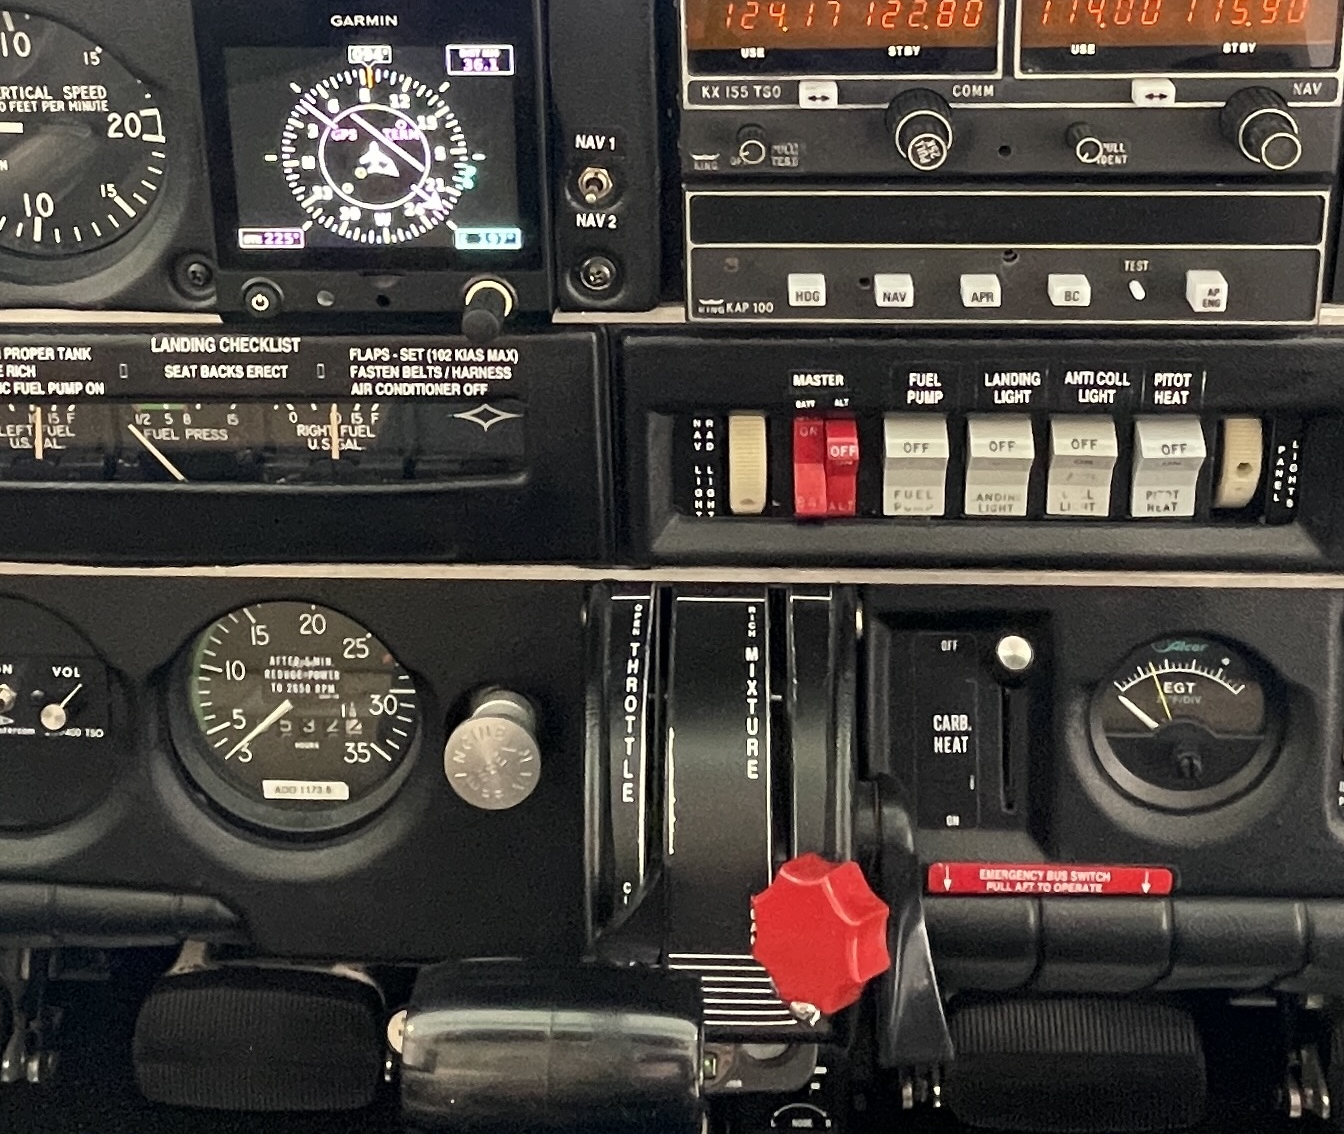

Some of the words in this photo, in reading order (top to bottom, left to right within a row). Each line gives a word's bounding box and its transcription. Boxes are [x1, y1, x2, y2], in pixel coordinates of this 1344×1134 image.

[330, 15, 399, 27] GARMIN
[725, 0, 842, 33] 124.17
[0, 31, 32, 58] 10
[63, 85, 107, 100] SPEED
[952, 85, 995, 98] COMM
[1292, 82, 1323, 96] NAV
[107, 112, 142, 138] 20
[575, 134, 604, 149] NAV
[609, 135, 616, 150] 1
[575, 214, 605, 228] NAV
[608, 214, 617, 228] 2
[1124, 260, 1150, 272] TEST
[795, 289, 820, 303] HDG
[882, 289, 908, 304] NAV
[970, 289, 995, 303] APR
[1063, 289, 1081, 303] BC
[725, 300, 753, 315] KAP
[754, 300, 774, 314] 100
[151, 337, 216, 353] LANDING
[219, 337, 301, 353] CHECKLIST
[4, 346, 55, 361] PROPER
[57, 346, 92, 361] TANK
[6, 364, 37, 378] RICH
[164, 364, 198, 379] SEAT
[200, 364, 244, 379] BACKS
[246, 364, 289, 379] ERECT
[1064, 371, 1094, 386] ANTI
[1096, 371, 1131, 386] COLL
[793, 374, 845, 387] MASTER
[909, 373, 942, 387] FUEL
[984, 372, 1041, 387] LANDING
[1154, 372, 1192, 387] PITOT
[351, 382, 372, 396] AIR
[375, 382, 461, 396] CONDITIONER
[463, 382, 488, 396] OFF
[993, 389, 1032, 404] LIGHT
[1078, 389, 1116, 404] LIGHT
[907, 390, 944, 405] PUMP
[1154, 391, 1190, 405] HEAT
[903, 442, 930, 454] OFF
[1071, 439, 1099, 450] OFF
[299, 613, 327, 635] 20
[343, 637, 369, 659] 25
[52, 666, 81, 678] VOL
[226, 660, 246, 681] 10
[1163, 682, 1195, 694] EGT
[745, 646, 759, 780] MIXTURE
[622, 642, 641, 803] THROTTLE
[932, 714, 972, 732] CARB.
[933, 735, 969, 753] HEAT
[979, 869, 1044, 882] EMERGENCY
[1046, 870, 1068, 882] BUS
[1070, 870, 1111, 882] SWITCH
